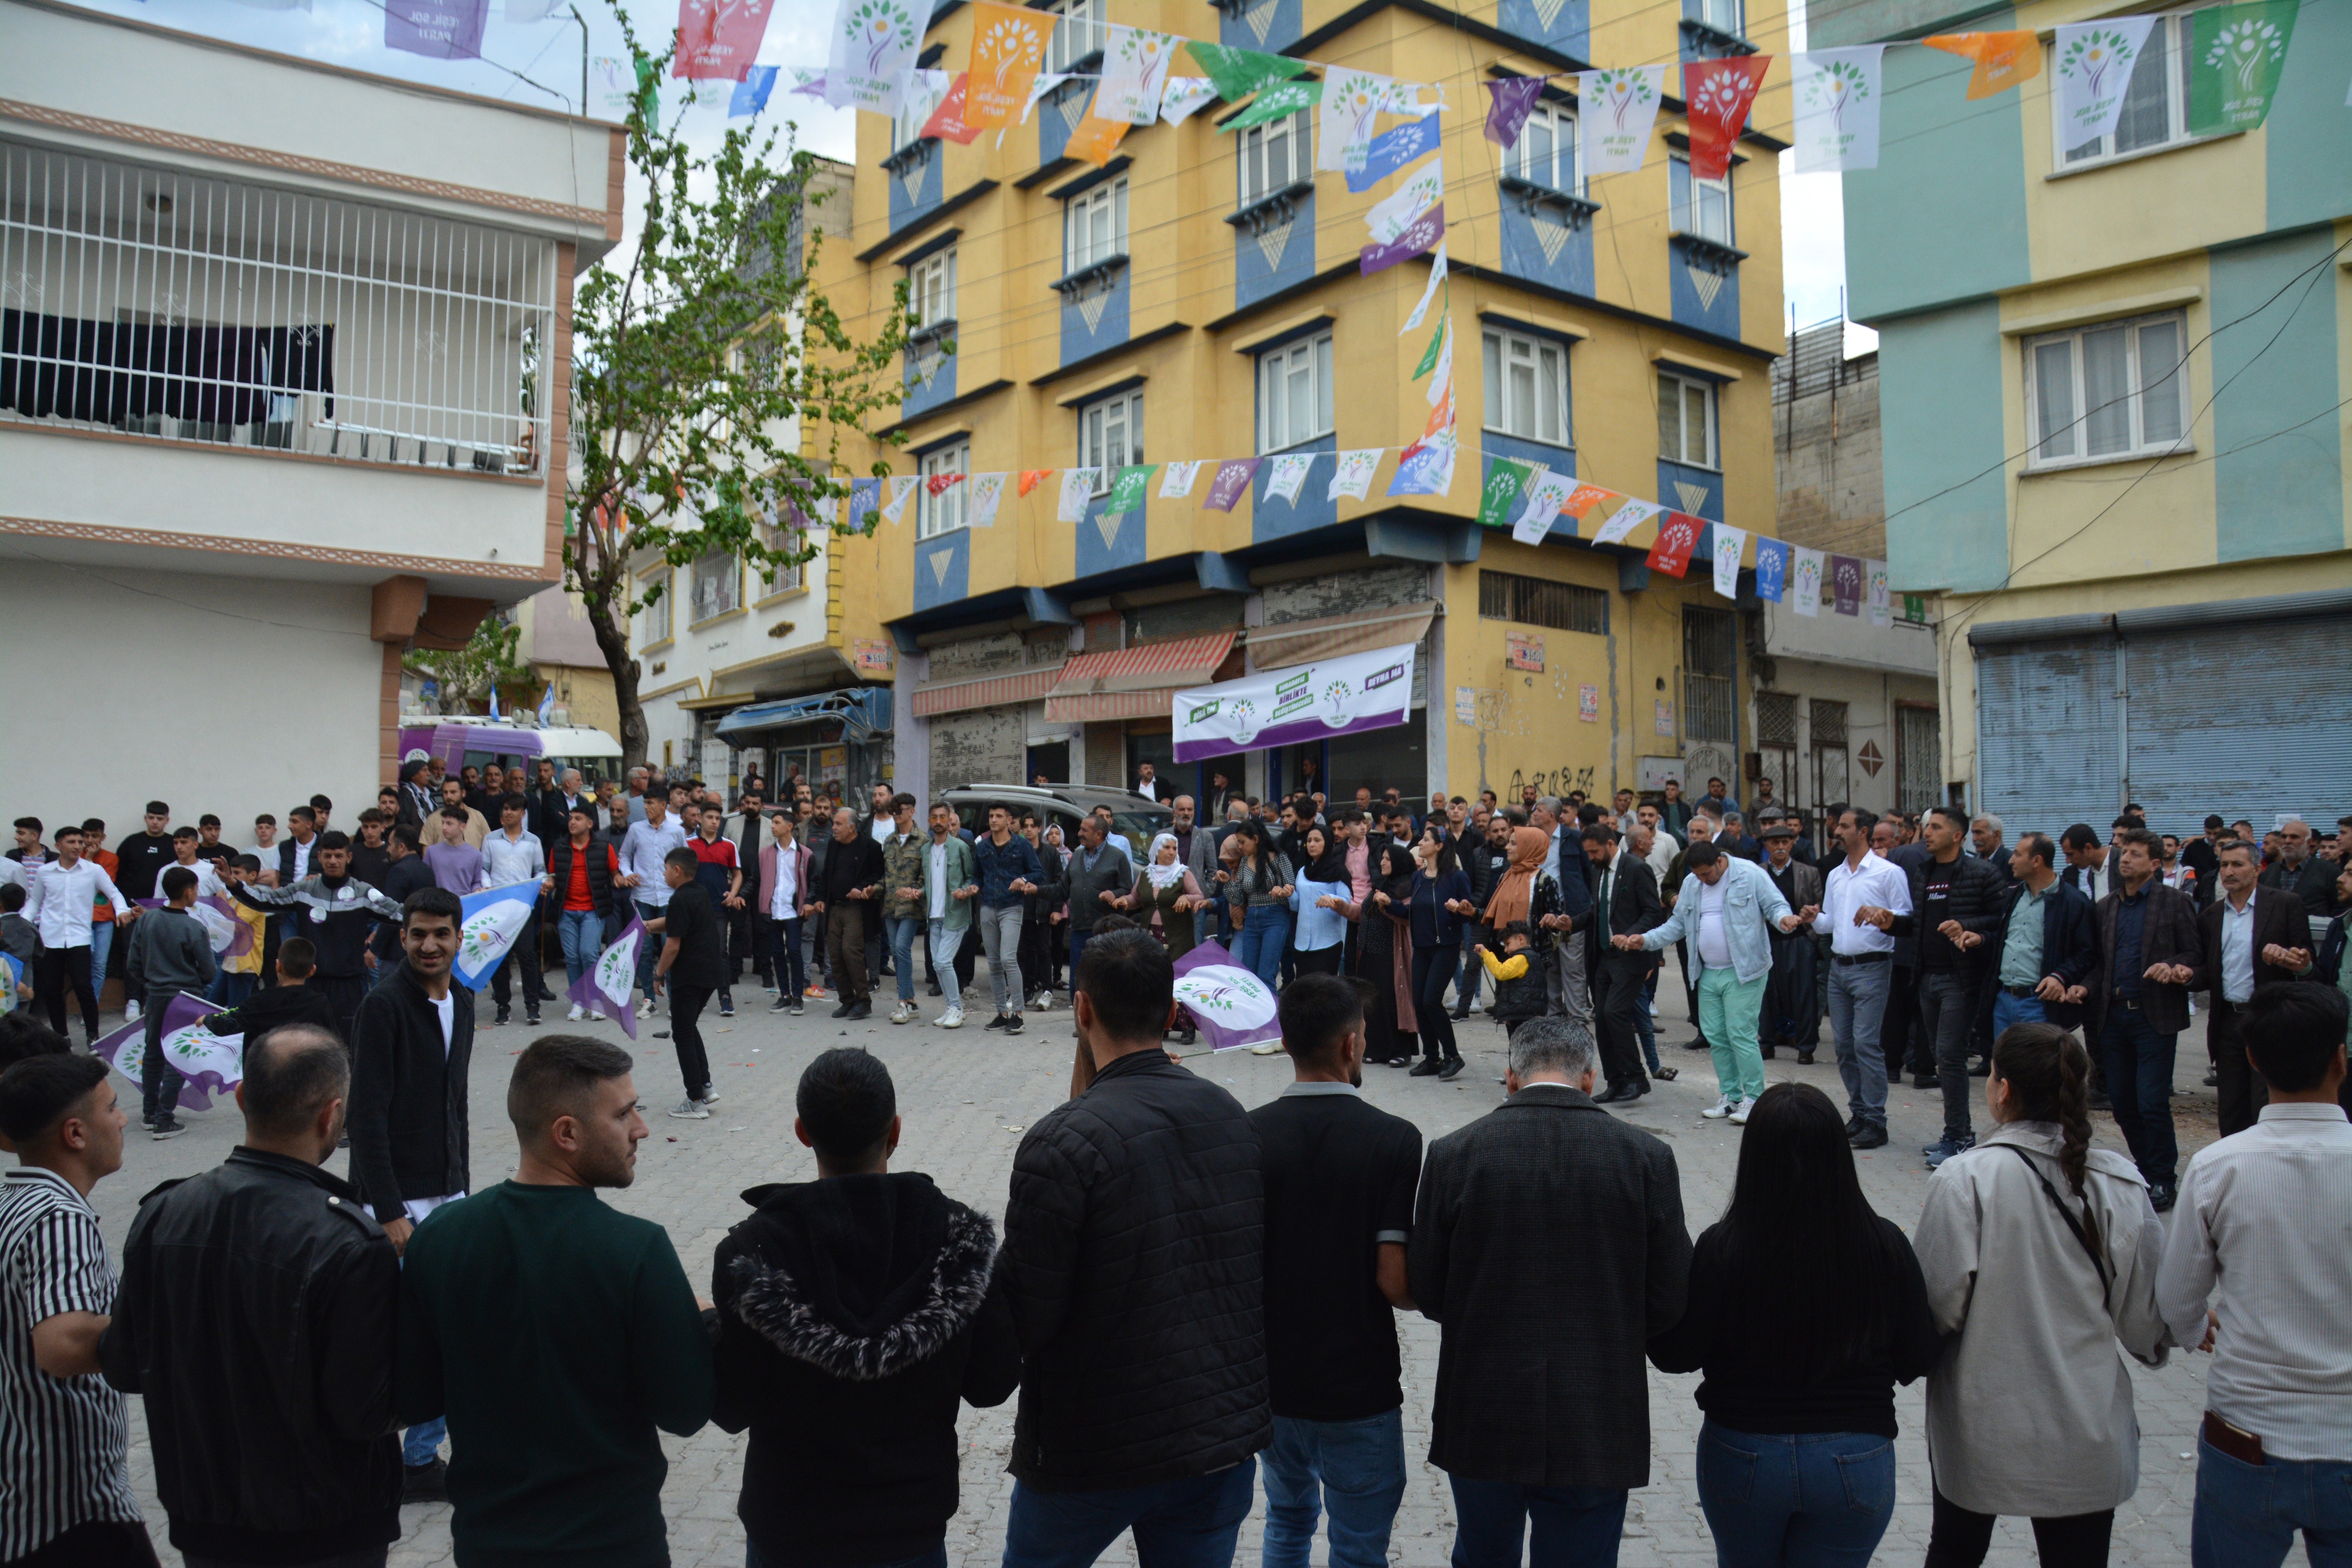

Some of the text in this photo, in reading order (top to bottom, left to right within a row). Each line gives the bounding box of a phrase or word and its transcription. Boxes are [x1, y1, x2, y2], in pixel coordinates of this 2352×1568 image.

[1279, 686, 1307, 705] BİRLİKTE
[1228, 976, 1258, 999] YEŞİL SOL
[1240, 977, 1261, 993] PARTİ
